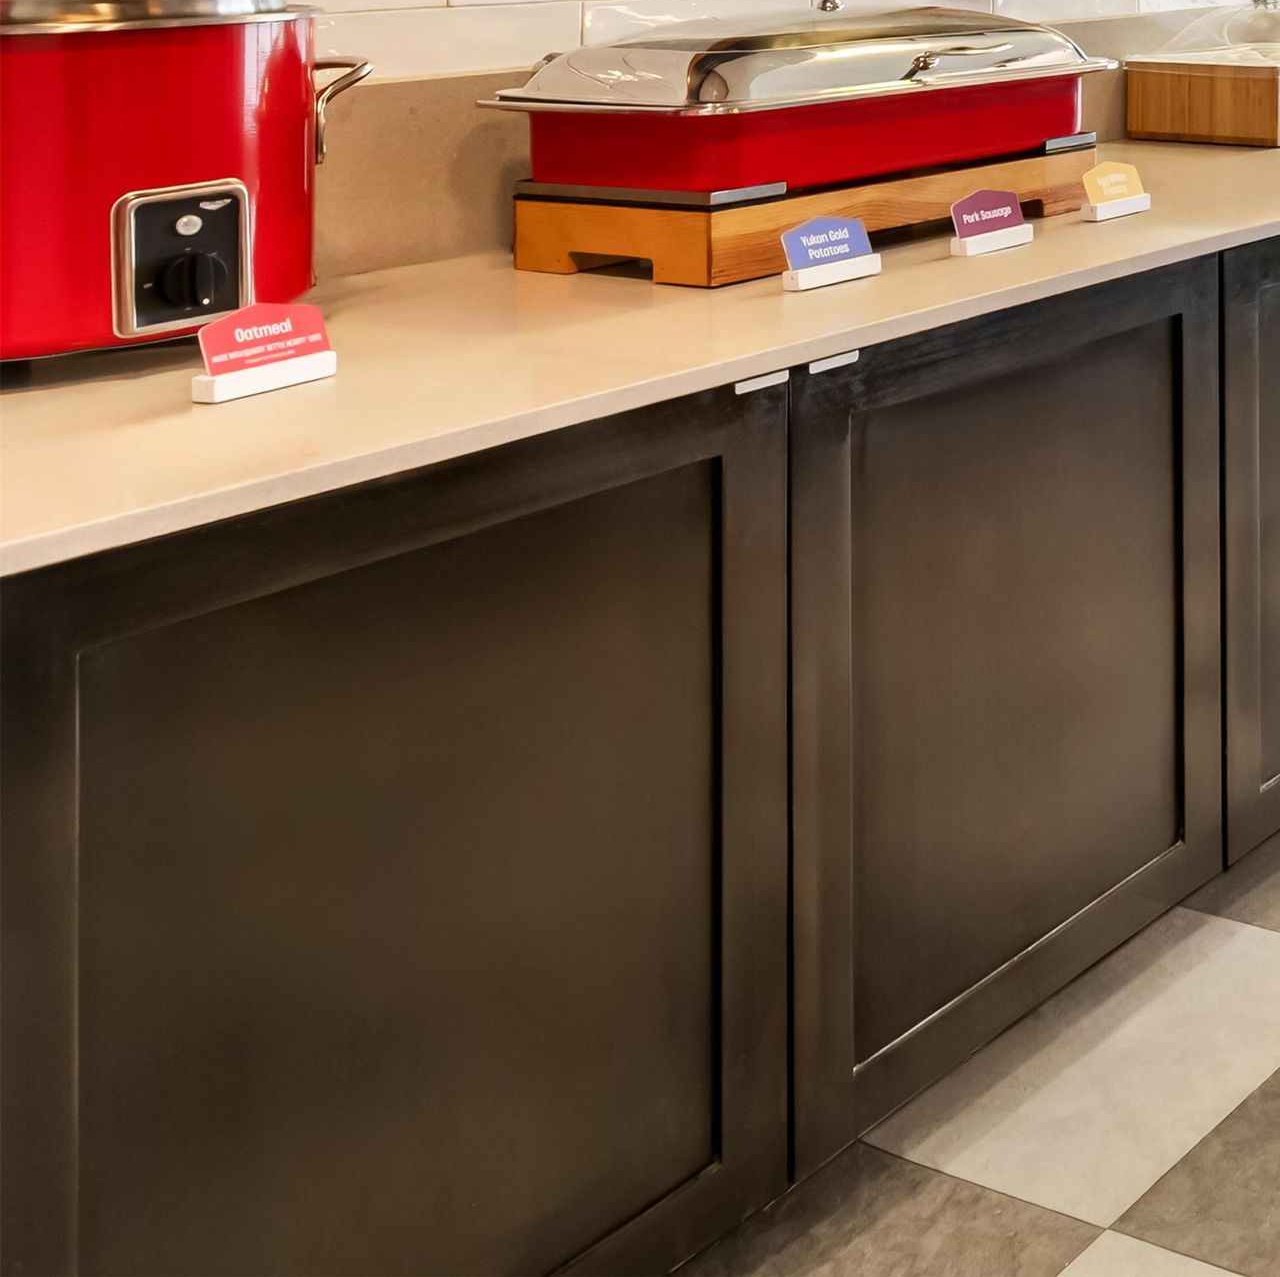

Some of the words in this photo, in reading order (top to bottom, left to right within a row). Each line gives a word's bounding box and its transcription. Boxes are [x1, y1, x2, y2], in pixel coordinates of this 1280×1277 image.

[962, 212, 981, 224] Pork
[980, 205, 1012, 220] Sausage
[800, 232, 829, 247] Yukon
[828, 227, 850, 241] Gold
[807, 243, 850, 260] Potatoes
[234, 318, 292, 342] Oatmeal
